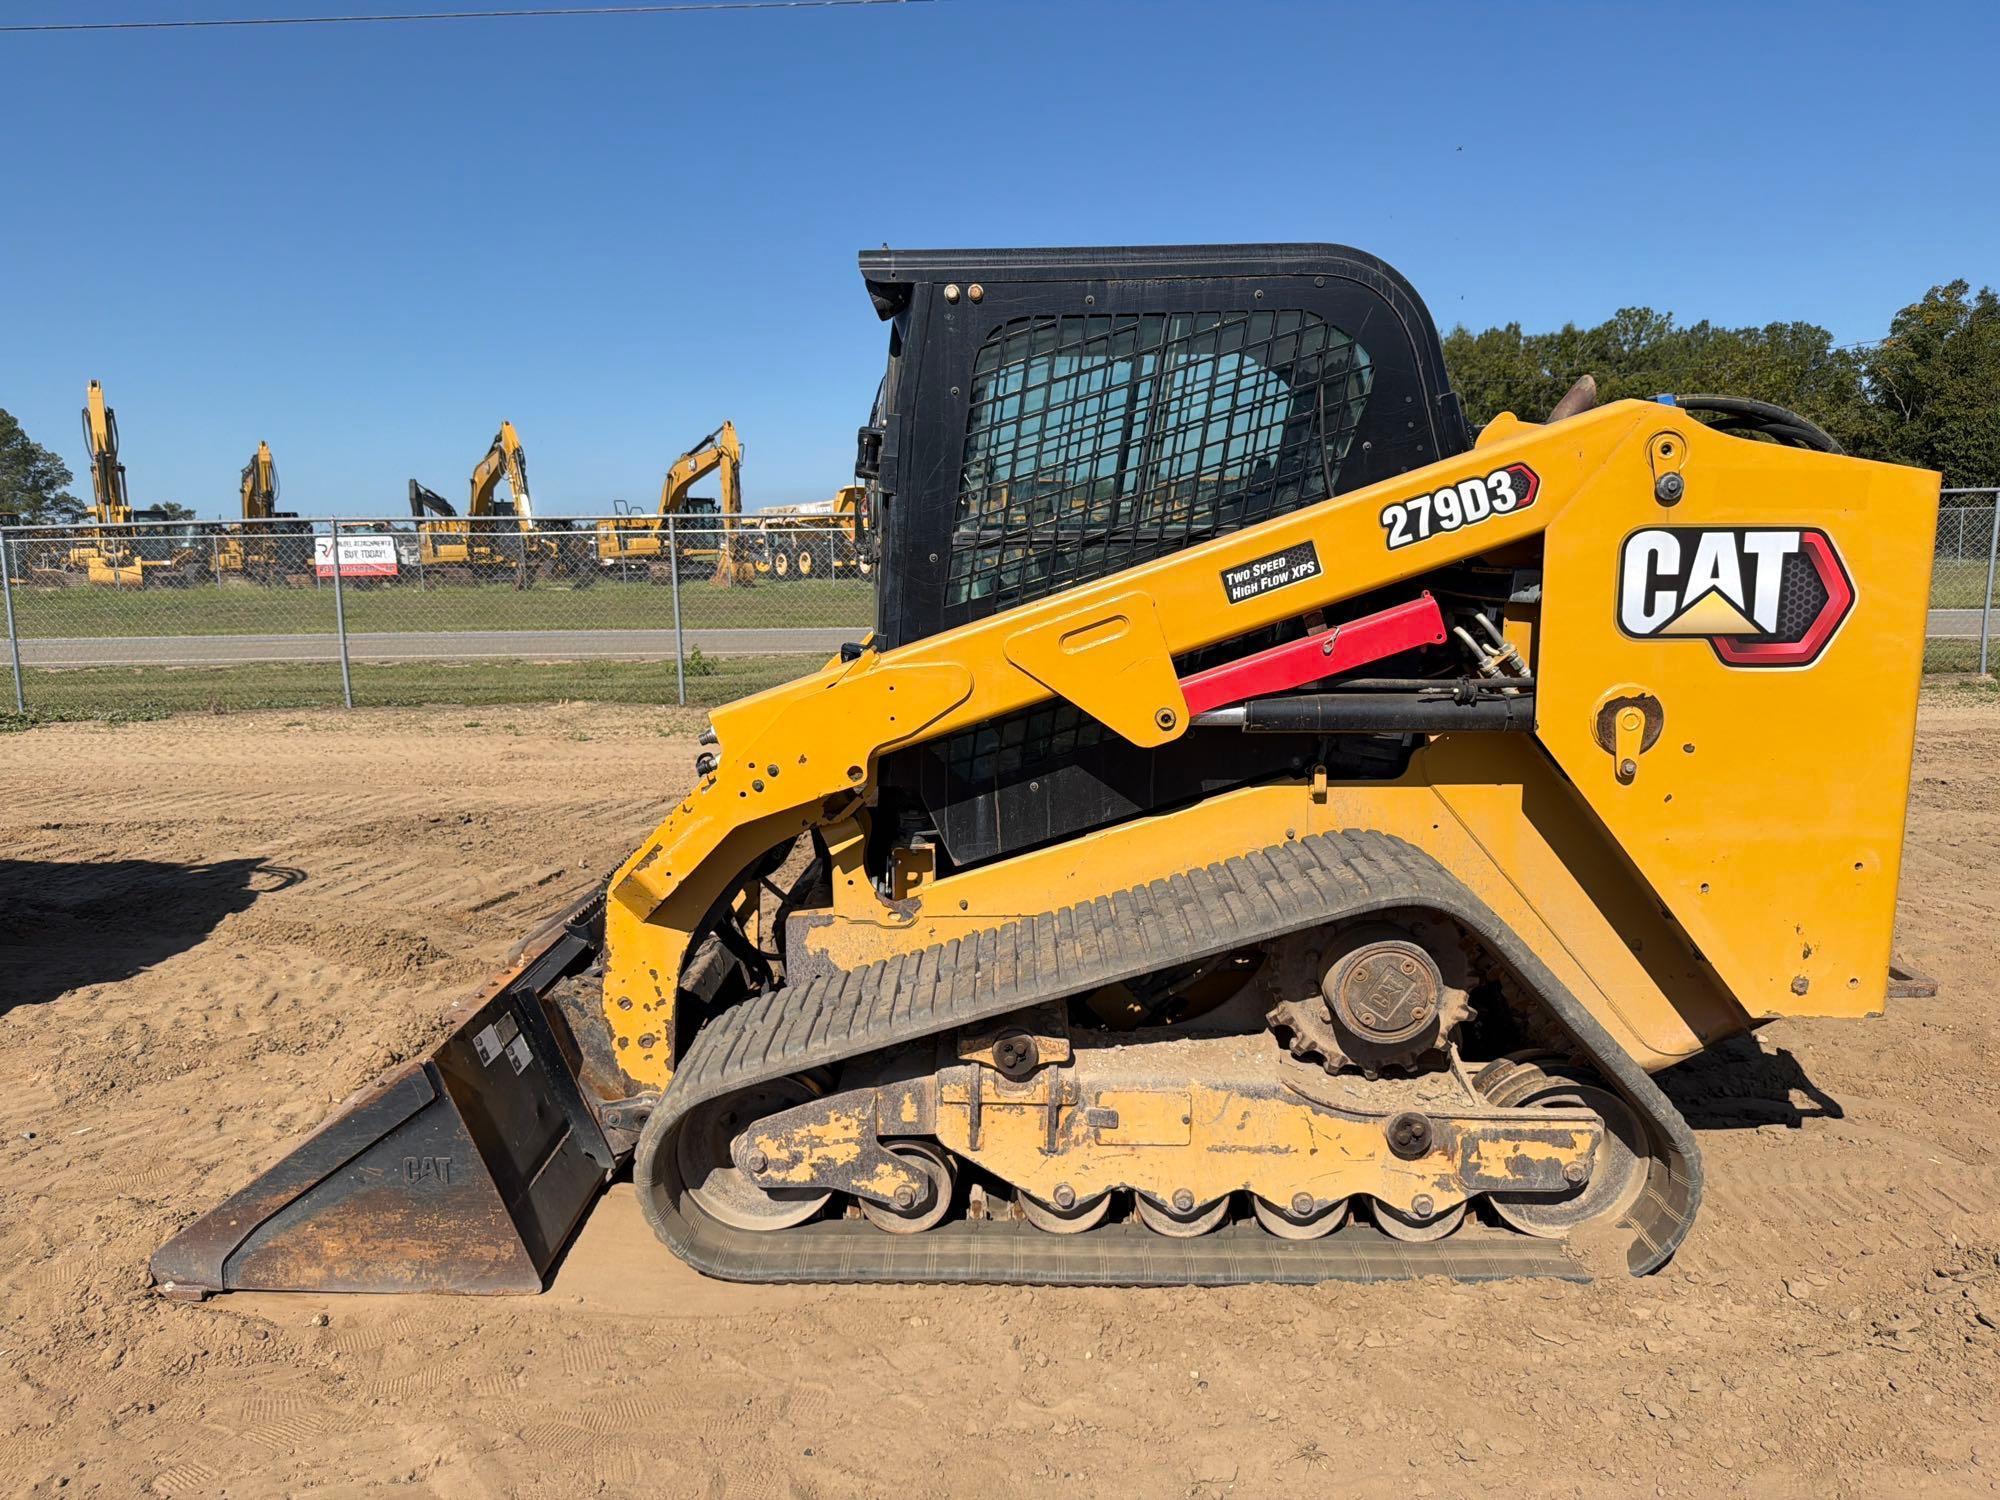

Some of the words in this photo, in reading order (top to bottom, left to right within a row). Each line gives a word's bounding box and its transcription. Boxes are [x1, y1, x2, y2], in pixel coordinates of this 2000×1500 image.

[1382, 470, 1517, 548] 279D3
[1226, 569, 1250, 586] TWO
[1252, 557, 1286, 577] SPEED
[1291, 561, 1315, 579] XPS
[1621, 530, 1800, 634] CAT
[1368, 973, 1406, 1008] CAT
[402, 1156, 452, 1185] CAT
